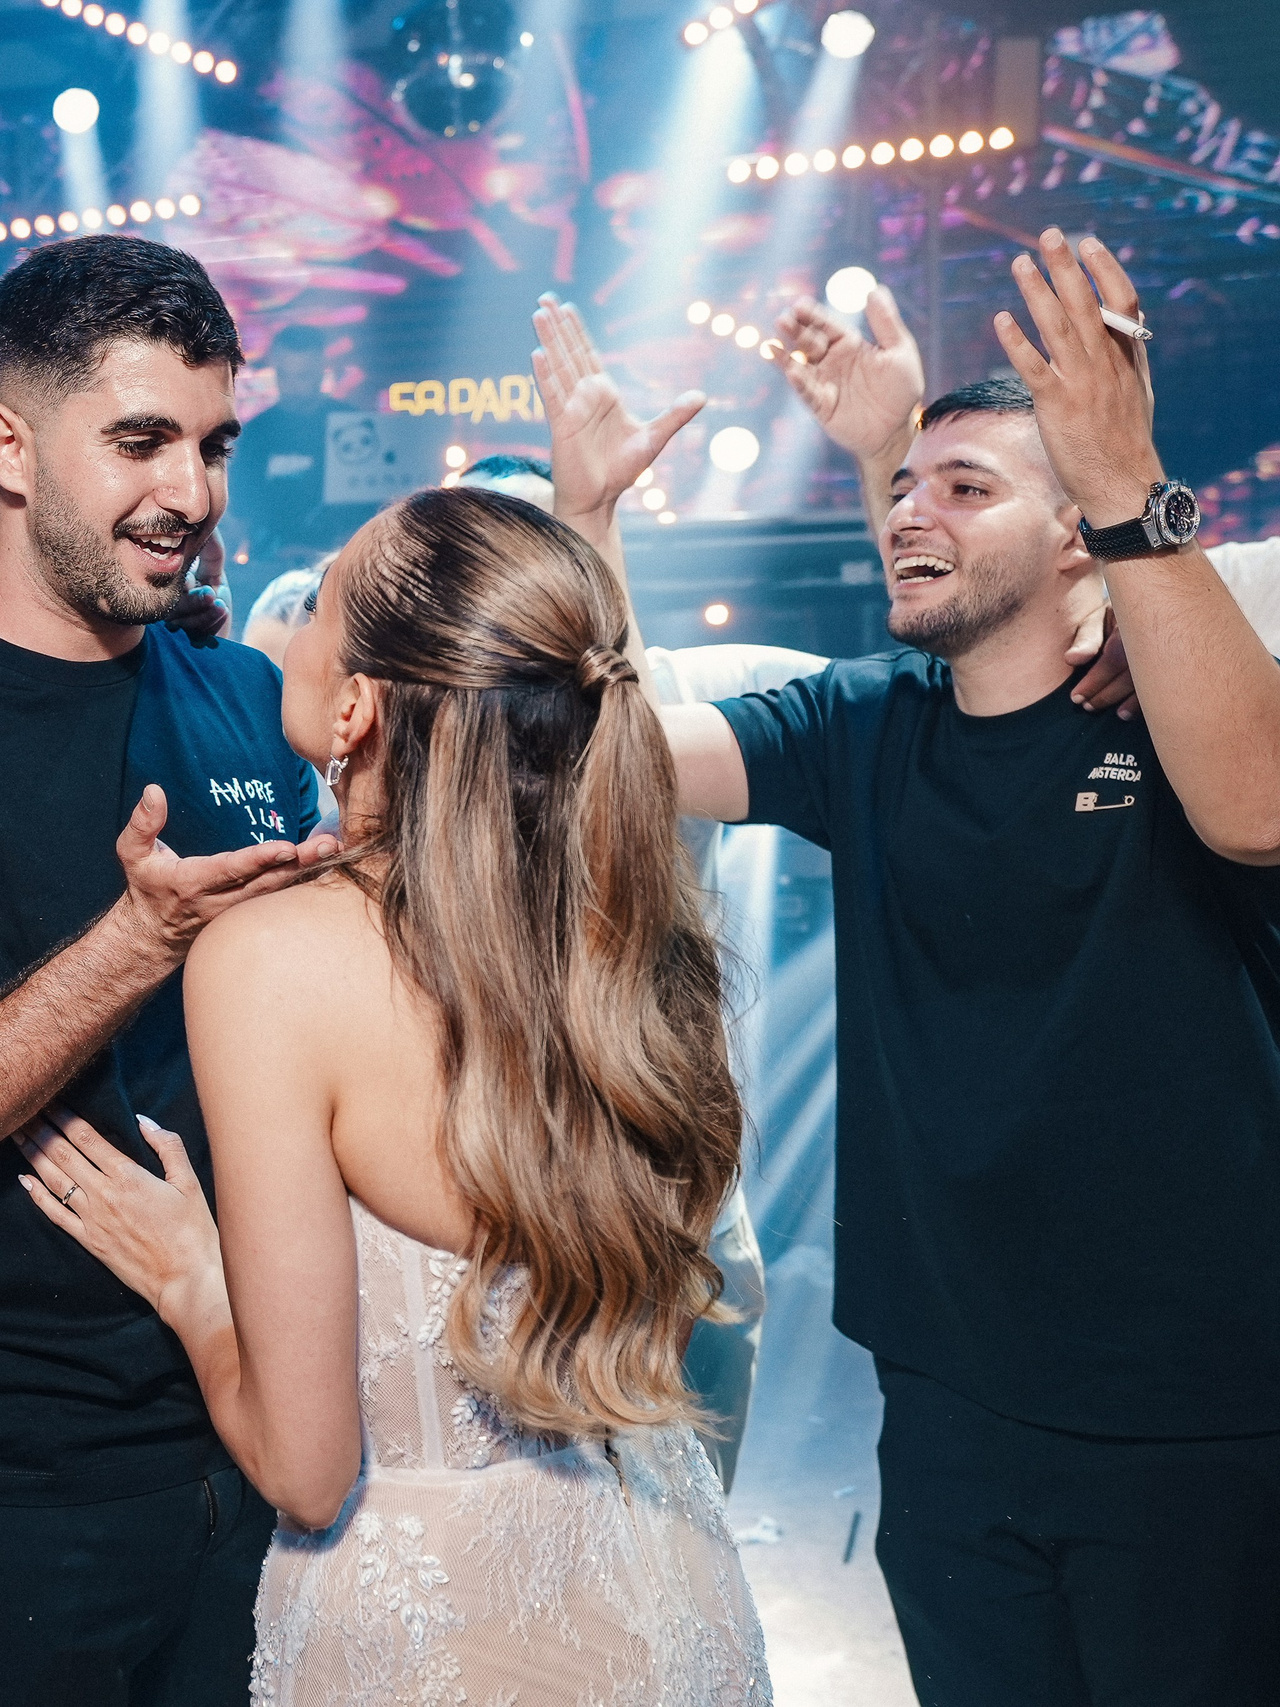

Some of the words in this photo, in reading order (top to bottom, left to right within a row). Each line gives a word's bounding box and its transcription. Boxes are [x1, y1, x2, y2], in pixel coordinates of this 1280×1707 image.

[1103, 752, 1138, 766] BALR.
[209, 777, 276, 807] AMORE
[244, 805, 257, 826] I
